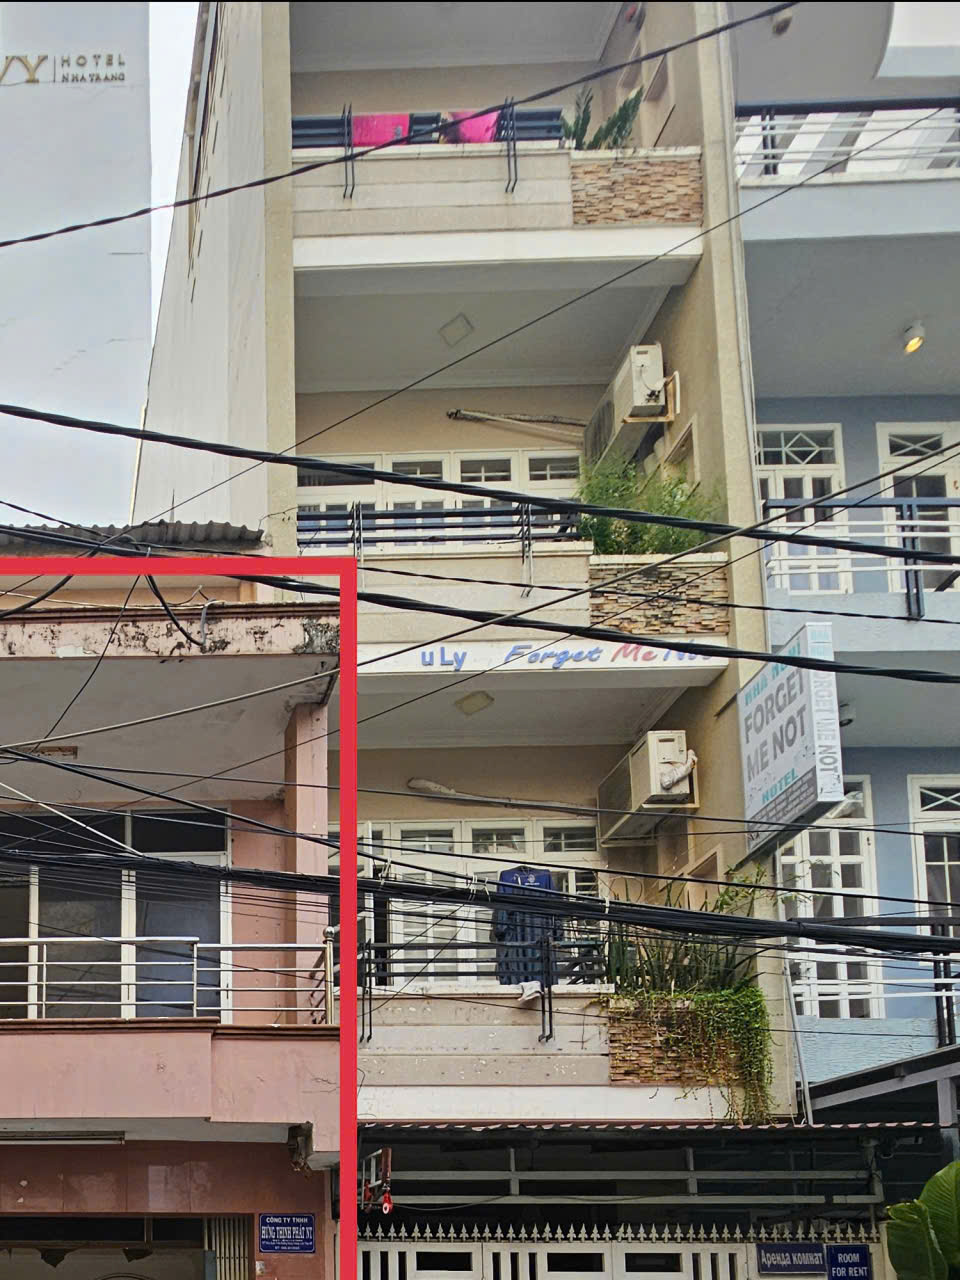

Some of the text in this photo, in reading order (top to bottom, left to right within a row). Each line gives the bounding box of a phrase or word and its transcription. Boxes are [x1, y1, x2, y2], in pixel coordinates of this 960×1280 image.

[61, 54, 125, 67] HOTEL
[504, 644, 603, 669] Forget
[611, 643, 658, 663] Me
[744, 667, 806, 744] FORGET
[746, 703, 807, 784] ME NOT
[818, 743, 839, 777] NOT
[761, 1249, 823, 1267] Аренда комнат
[837, 1253, 860, 1263] ROOM
[831, 1267, 868, 1277] FOR RENT
